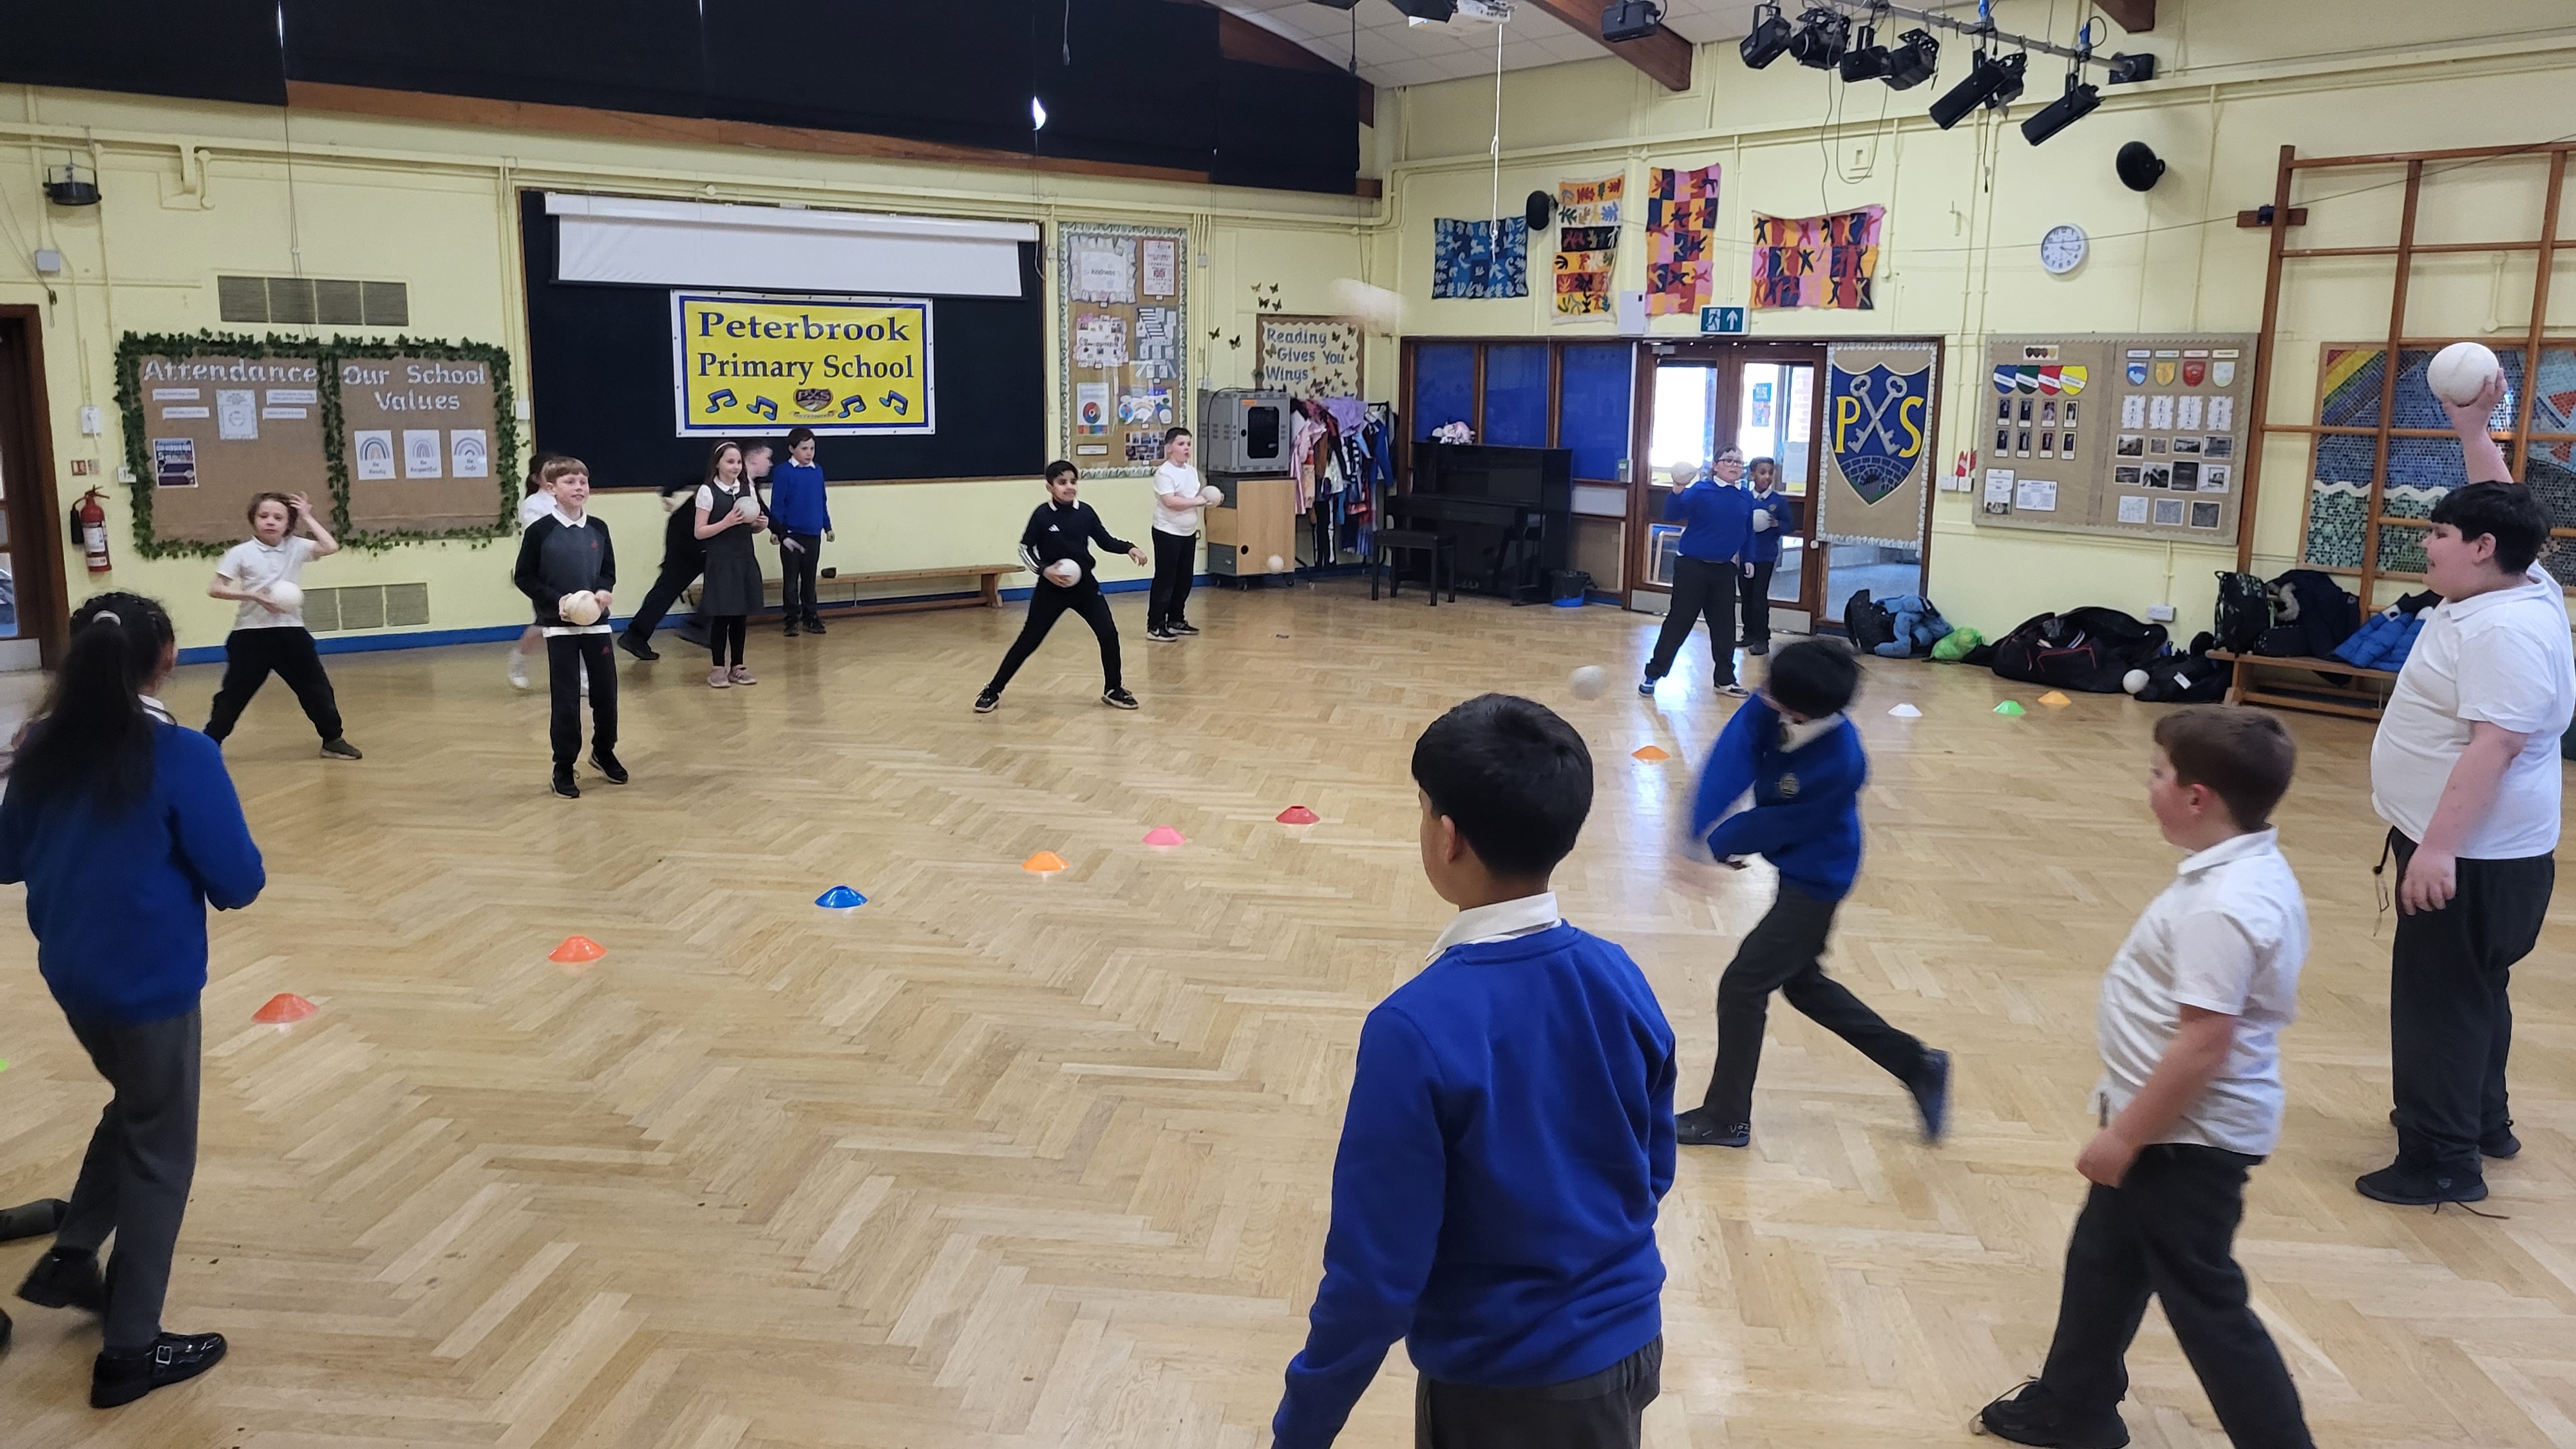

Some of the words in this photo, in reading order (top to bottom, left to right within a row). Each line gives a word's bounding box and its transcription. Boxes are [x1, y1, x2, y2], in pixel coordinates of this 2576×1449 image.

[697, 312, 909, 341] Peterbrook
[1267, 327, 1327, 348] Reading
[1277, 347, 1316, 363] Gives
[1322, 350, 1345, 365] You
[144, 358, 317, 383] Attendance
[343, 365, 390, 385] Our
[407, 363, 486, 384] School
[697, 352, 814, 386] Primary
[824, 354, 914, 379] School
[1265, 365, 1309, 384] Wings
[374, 388, 460, 412] Values
[798, 391, 809, 400] P
[820, 390, 830, 400] S
[1835, 395, 1861, 454] P
[1898, 395, 1924, 458] S
